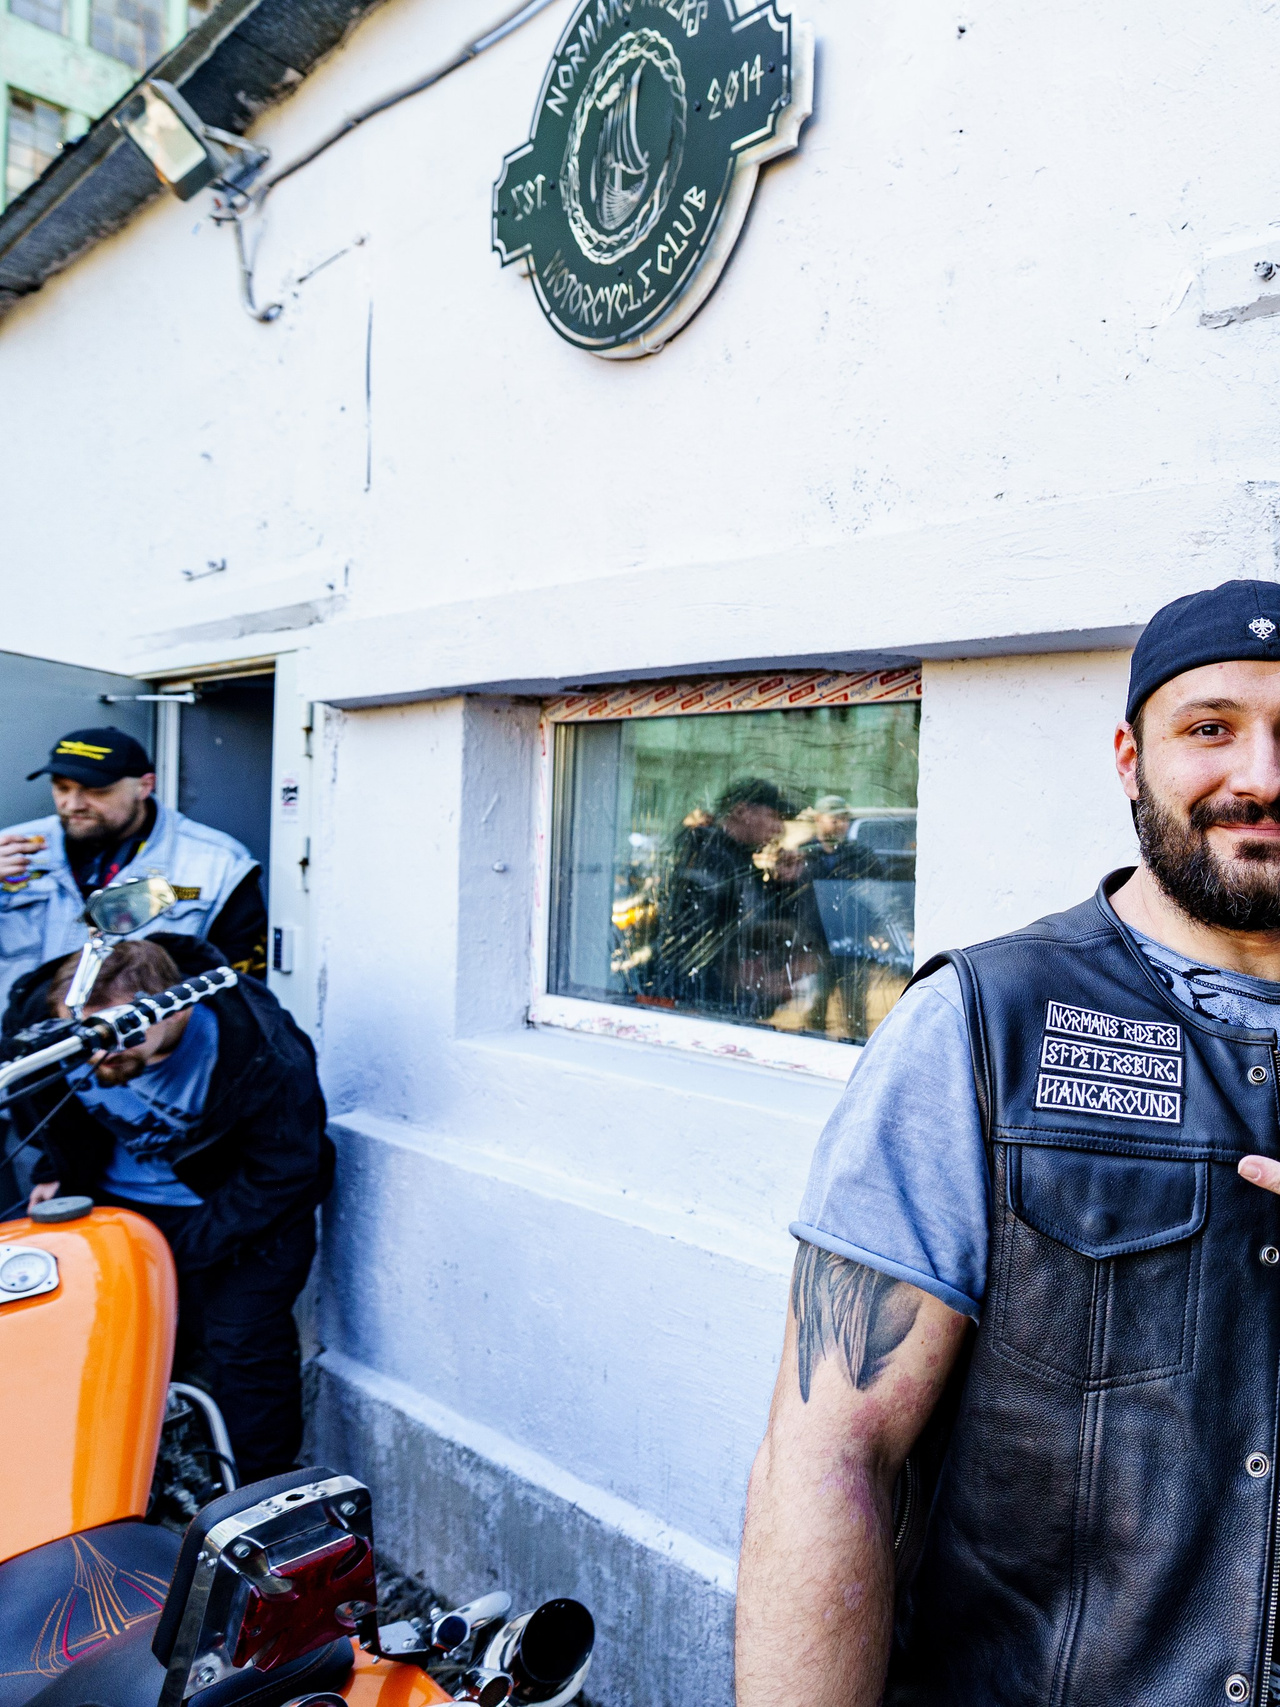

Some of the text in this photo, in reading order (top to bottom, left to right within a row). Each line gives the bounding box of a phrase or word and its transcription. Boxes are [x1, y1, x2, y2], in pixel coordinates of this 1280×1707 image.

[543, 185, 707, 326] MOTORCYCLE CLUB
[1051, 1005, 1176, 1046] NORMANS RIDERS
[1041, 1078, 1176, 1118] HANGAROUND
